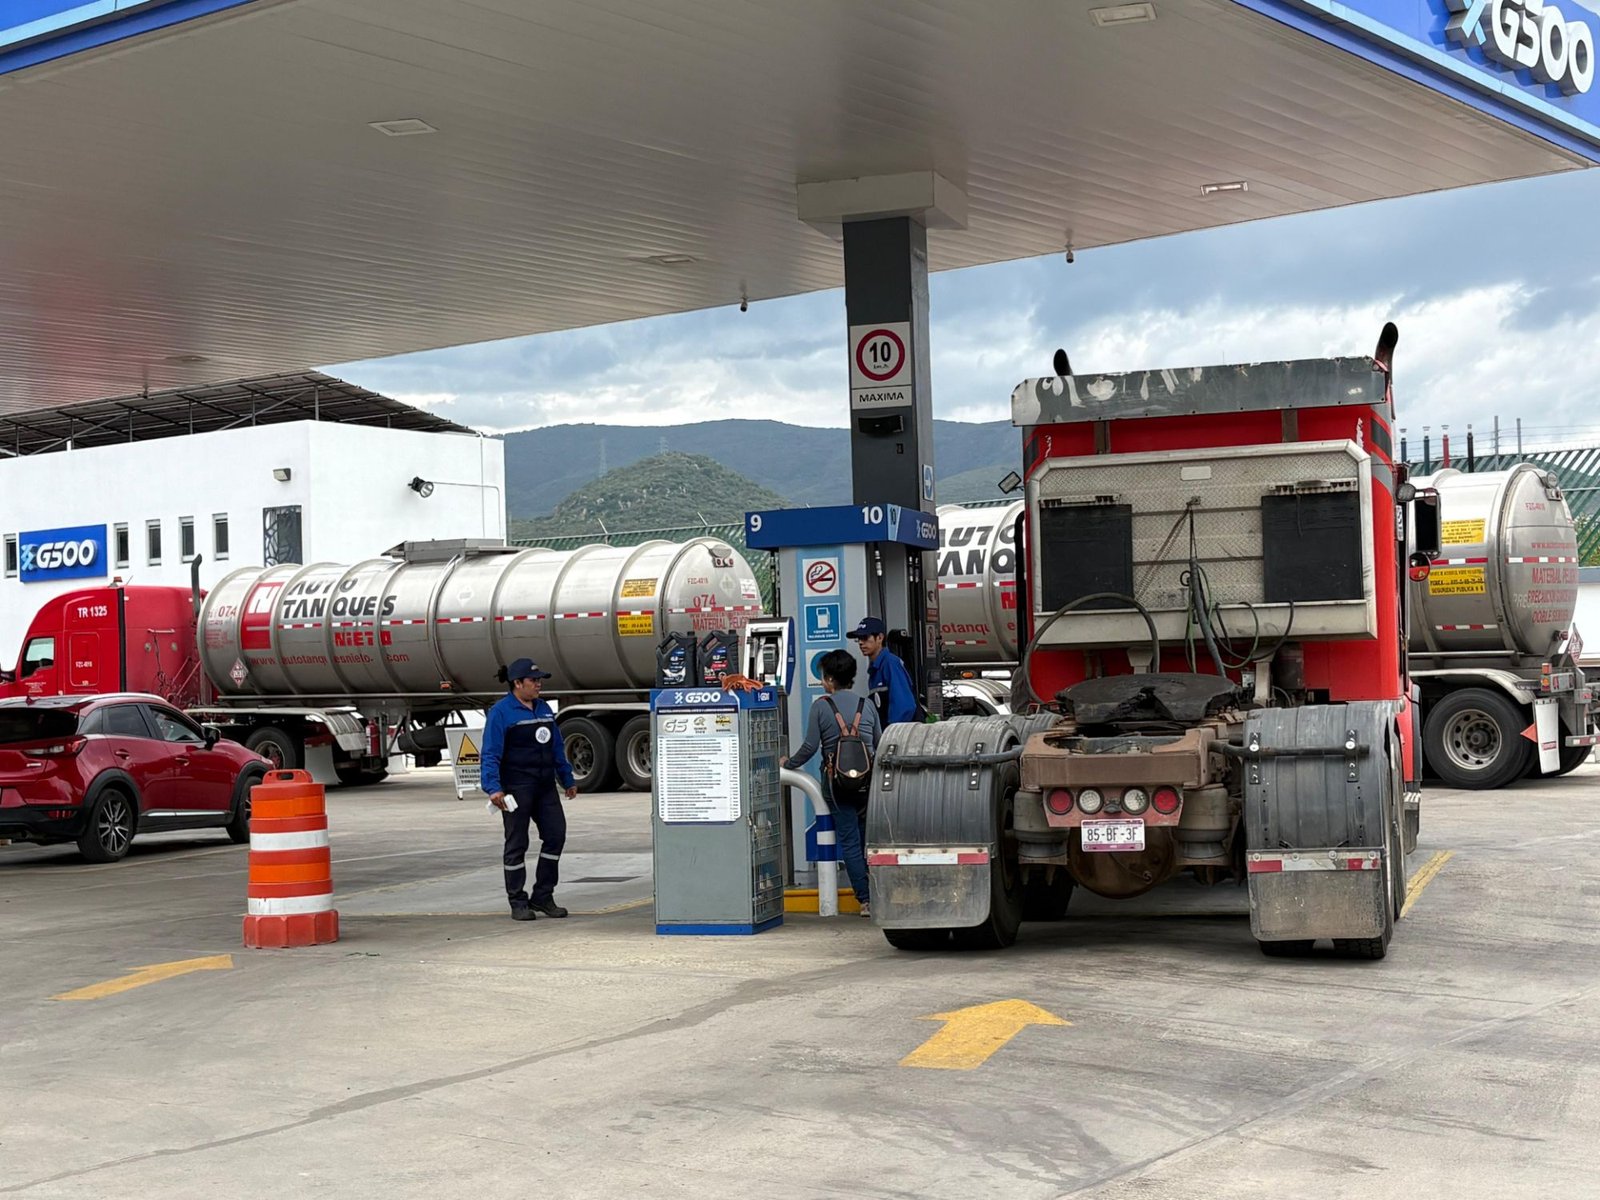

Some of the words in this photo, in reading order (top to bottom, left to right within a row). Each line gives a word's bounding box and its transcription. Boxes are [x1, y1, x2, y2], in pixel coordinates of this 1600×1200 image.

[1491, 0, 1595, 93] G500
[869, 341, 891, 363] 10
[859, 392, 904, 403] MAXIMA
[750, 514, 762, 532] 9
[862, 506, 883, 525] 10
[36, 539, 96, 569] G500
[282, 595, 398, 618] TANQUES
[693, 594, 716, 608] 074
[77, 607, 89, 618] TR
[90, 605, 108, 617] 1325
[685, 691, 721, 704] G500
[1087, 827, 1138, 841] 85-BF-3F
